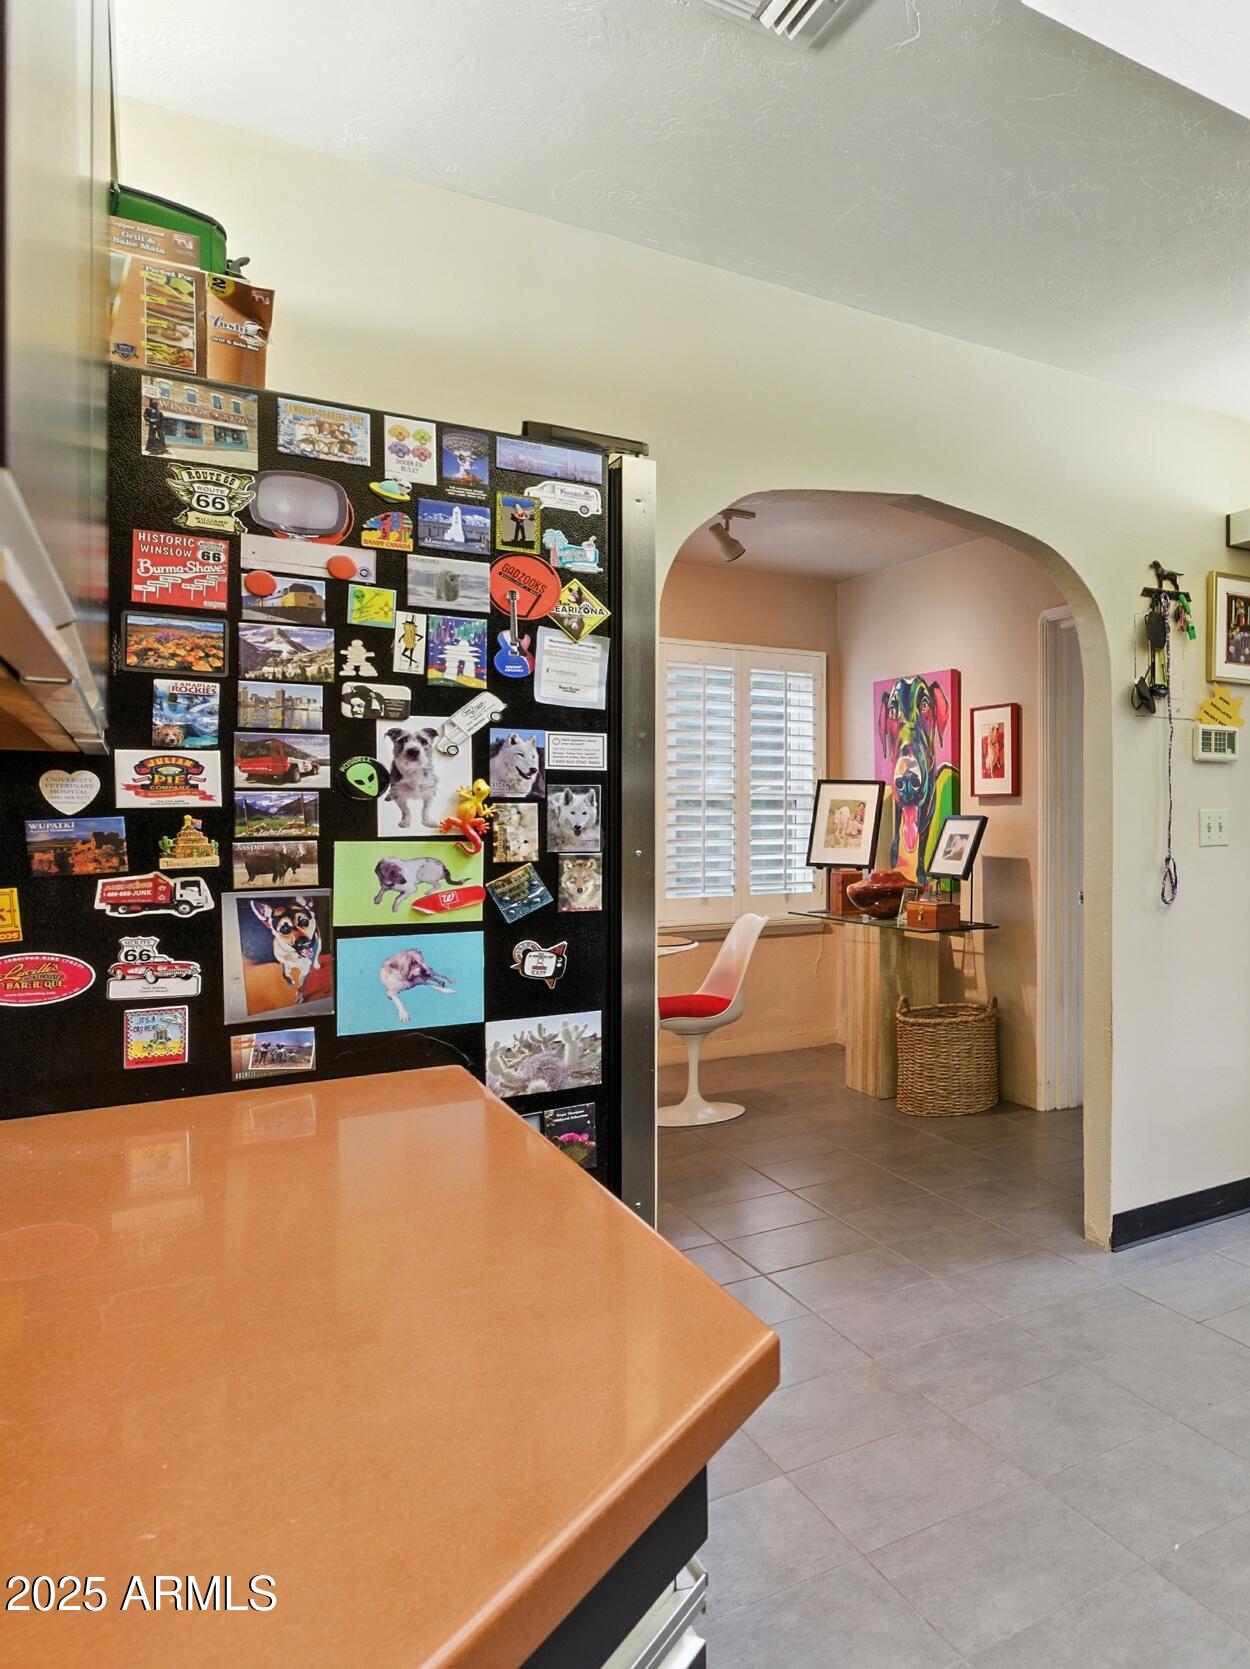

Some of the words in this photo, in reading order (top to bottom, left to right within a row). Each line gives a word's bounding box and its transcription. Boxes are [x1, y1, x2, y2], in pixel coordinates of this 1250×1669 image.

[212, 277, 226, 289] 2
[186, 471, 222, 483] ROUTE
[223, 476, 236, 486] 66
[197, 485, 226, 495] ROUTE
[196, 494, 226, 511] 66
[138, 532, 195, 547] HISTORIC
[140, 544, 192, 557] WINSLOW
[201, 550, 222, 562] 66
[137, 558, 226, 577] Burma-Shave
[501, 563, 547, 594] GADZOOKS
[553, 606, 605, 616] EARIZONA
[171, 685, 217, 694] ROCKIES
[147, 757, 194, 768] JULIAN
[154, 774, 186, 785] PIE
[28, 821, 75, 830] WUPATKI
[124, 949, 152, 962] 66
[1, 962, 59, 980] Lucille's
